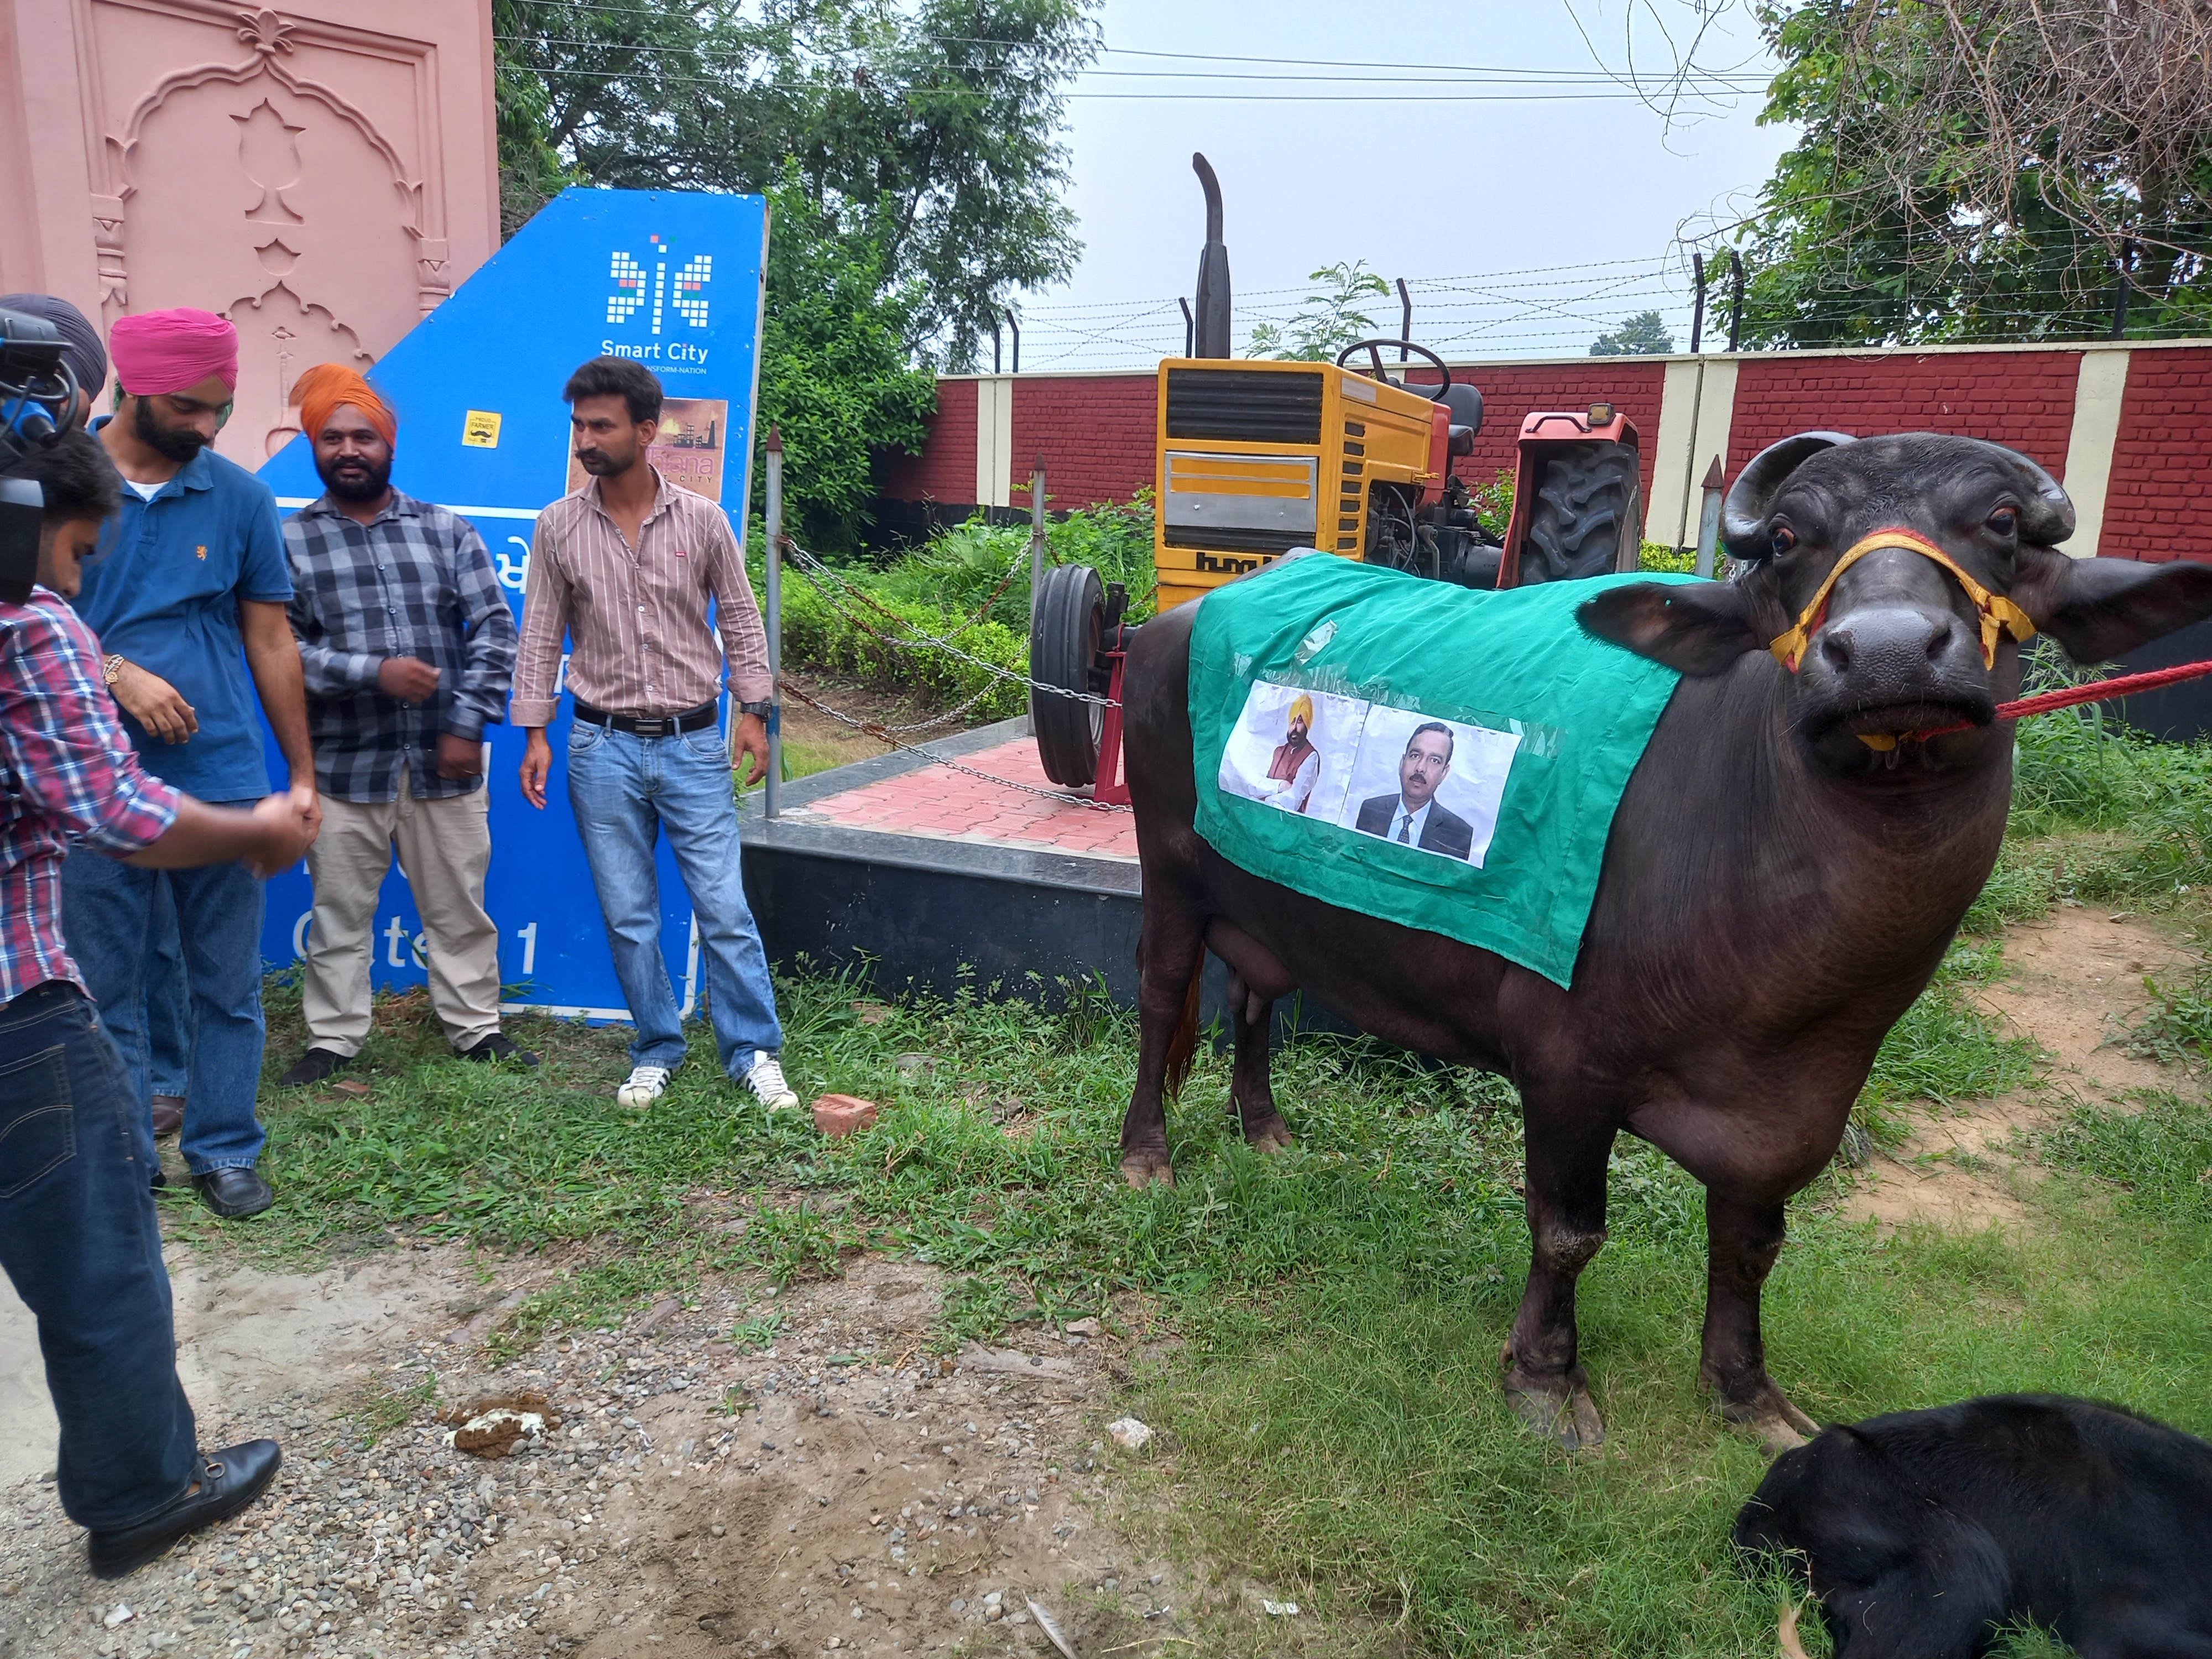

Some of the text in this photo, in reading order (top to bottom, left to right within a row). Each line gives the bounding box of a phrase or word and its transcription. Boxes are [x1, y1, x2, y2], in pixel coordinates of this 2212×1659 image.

[601, 340, 708, 364] Smart City
[679, 475, 712, 483] CITY
[518, 922, 538, 974] 1
